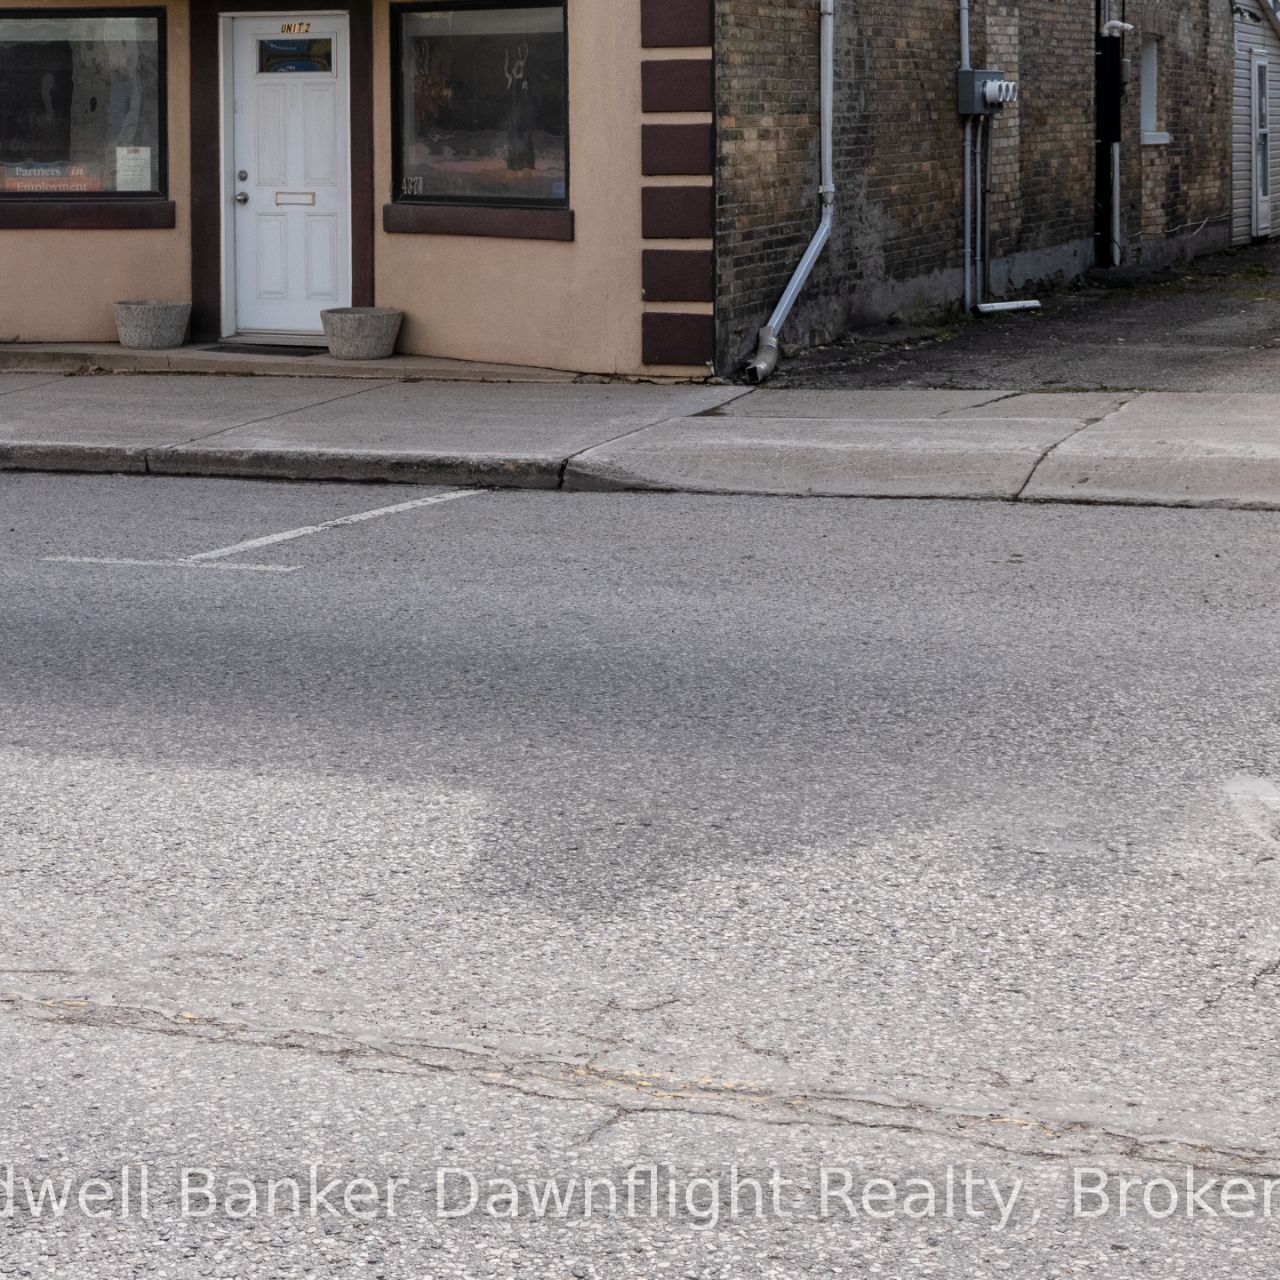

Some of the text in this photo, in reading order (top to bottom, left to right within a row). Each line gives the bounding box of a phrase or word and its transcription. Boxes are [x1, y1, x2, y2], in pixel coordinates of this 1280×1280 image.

[281, 23, 311, 33] UNIT 2
[16, 166, 84, 176] Partners in
[17, 182, 88, 192] Employment
